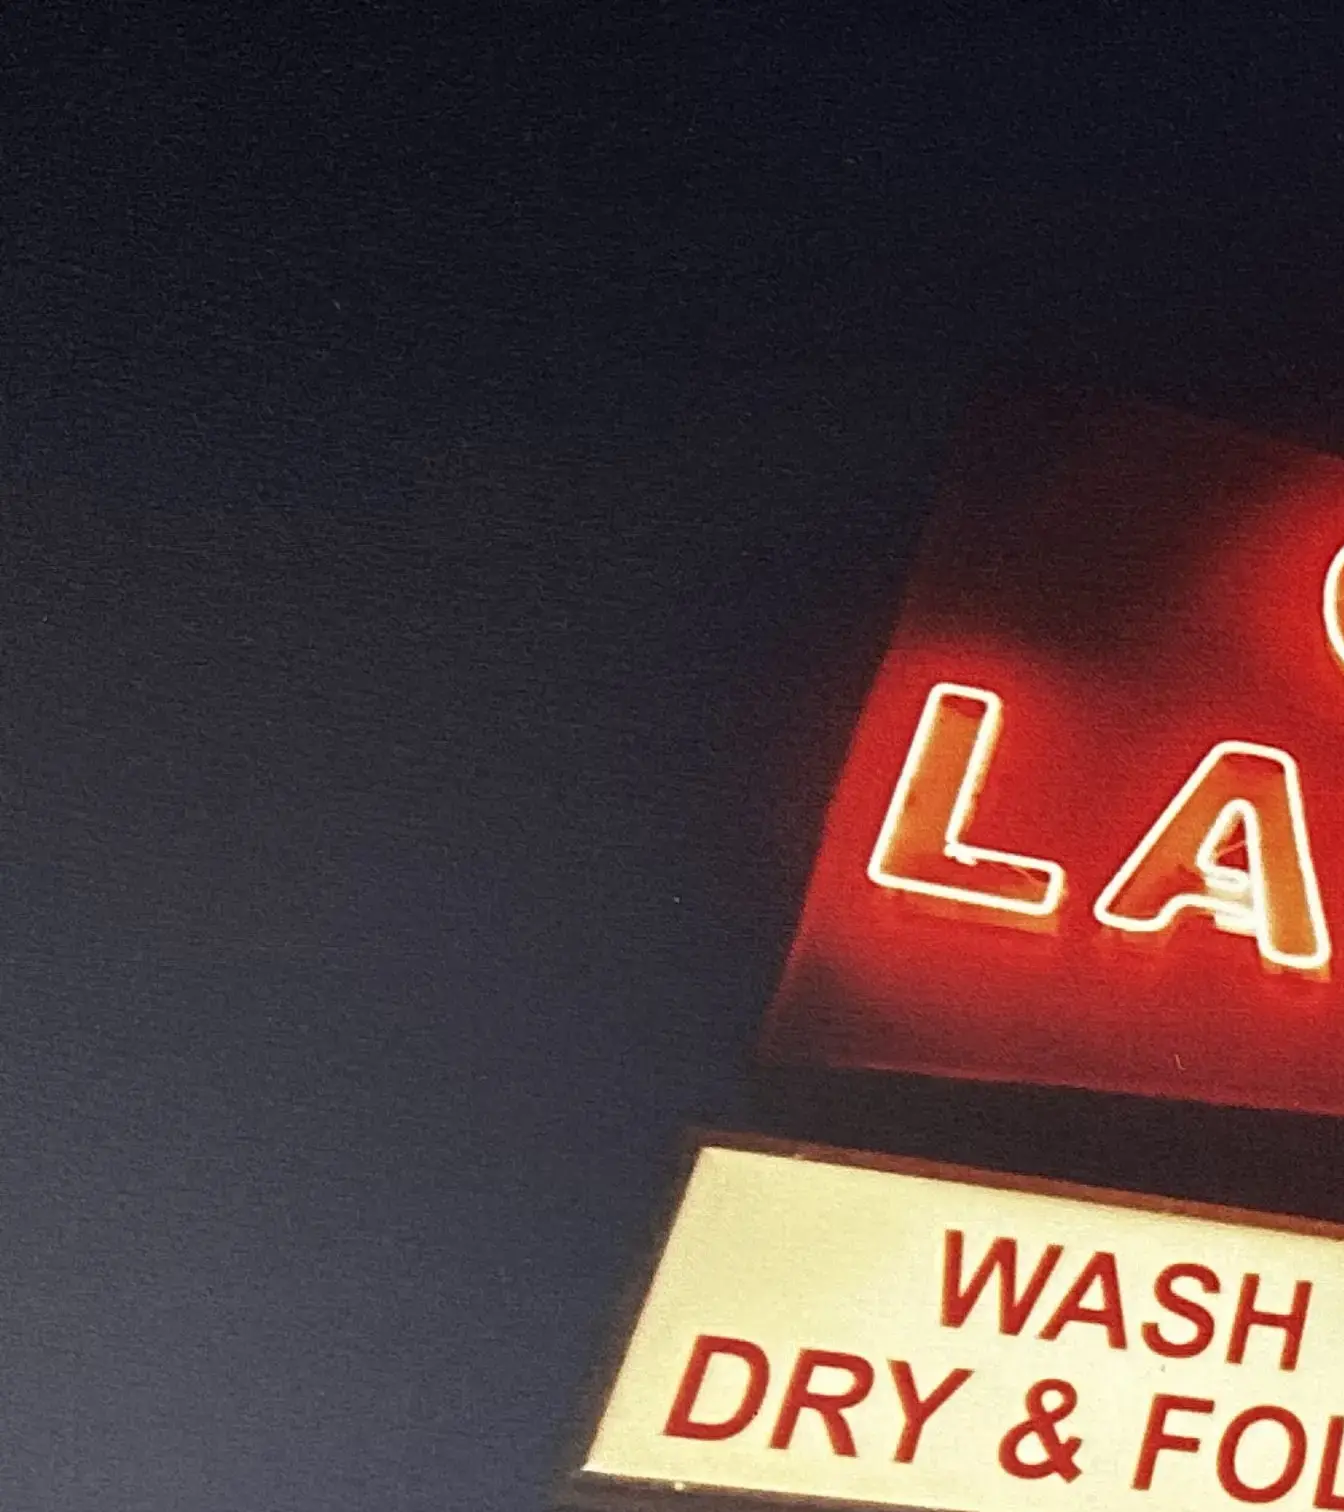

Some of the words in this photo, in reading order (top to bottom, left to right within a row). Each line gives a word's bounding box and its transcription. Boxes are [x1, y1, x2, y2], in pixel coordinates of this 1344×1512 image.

[940, 1229, 1313, 1371] WASH
[662, 1334, 974, 1464] DRY
[998, 1378, 1083, 1484] &
